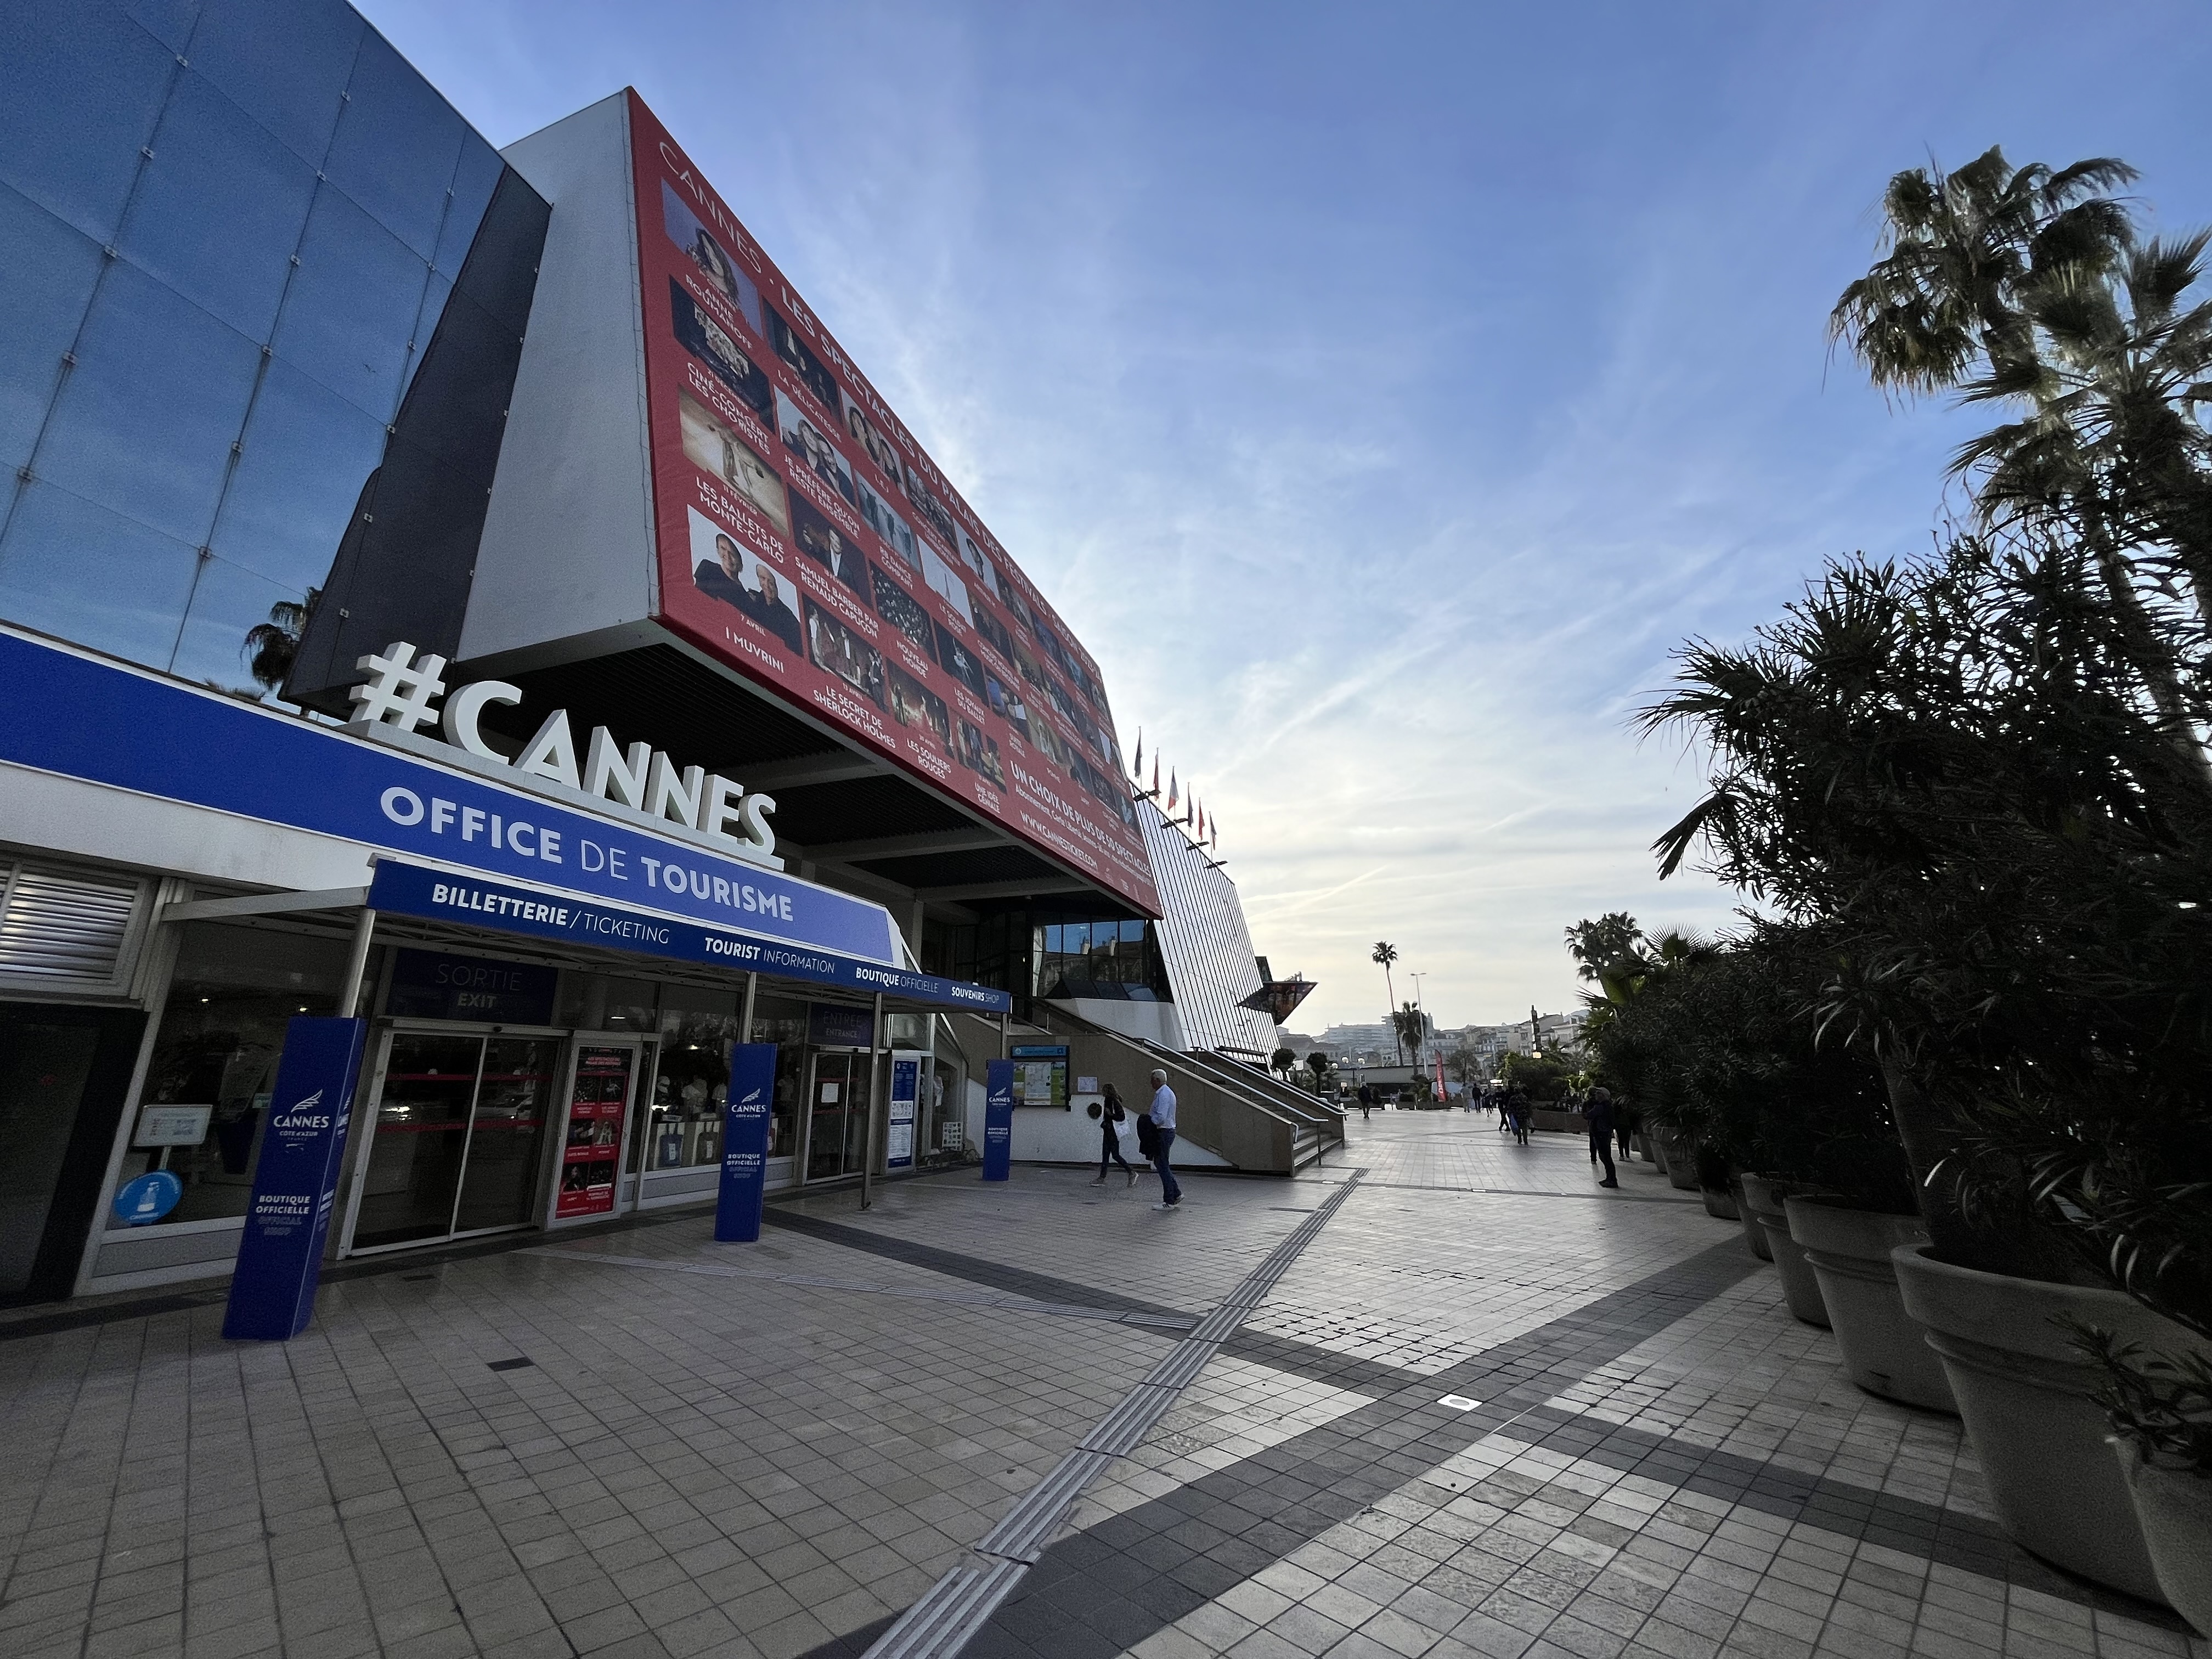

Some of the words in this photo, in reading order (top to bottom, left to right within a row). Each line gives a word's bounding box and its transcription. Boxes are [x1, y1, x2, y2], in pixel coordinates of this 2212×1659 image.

[686, 274, 752, 348] ROUMANOFF
[705, 288, 733, 322] ANNE
[659, 142, 761, 273] CANNES
[781, 286, 815, 337] LES
[821, 335, 915, 456] SPECTACLES
[918, 452, 938, 484] DU
[941, 480, 980, 535] PALAIS
[981, 530, 1002, 562] DES
[1003, 556, 1046, 615] FESTIVALS
[716, 376, 748, 411] DÉCEMBRE
[687, 362, 768, 442] CINÉ-CONCERT
[689, 373, 708, 397] LES
[712, 396, 770, 454] CHORISTES
[777, 369, 789, 386] LA
[791, 384, 841, 442] DÉLICATESSE
[729, 486, 757, 516] FÉVRIER
[784, 454, 794, 469] JE
[795, 465, 831, 504] PRÉFÈRE
[833, 502, 860, 531] QU'ON
[789, 467, 816, 498] RESTE
[817, 495, 858, 538] ENSEMBLE
[696, 476, 717, 500] LES
[721, 496, 767, 539] BALLETS
[770, 535, 784, 554] DE
[700, 492, 783, 563] MONTE-CARLO
[881, 556, 912, 589] COMPANY
[890, 556, 912, 582] DANCE
[795, 556, 830, 592] SAMUEL
[832, 586, 863, 618] BARBER
[864, 613, 878, 631] PAR
[801, 571, 837, 606] RENAUD
[839, 603, 877, 638] CAPUÇON
[746, 619, 765, 636] AVRIL
[725, 626, 729, 639] I
[733, 633, 783, 673] MUVRINI
[896, 640, 928, 670] NOUVEAU
[902, 654, 926, 678] MONDE
[826, 685, 837, 700] LE
[838, 693, 868, 720] SECRET
[871, 714, 883, 729] DE
[842, 682, 848, 691] 13
[849, 687, 864, 701] AVRIL
[954, 687, 964, 700] LES
[957, 697, 966, 710] DU
[813, 690, 861, 727] SHERLOCK
[862, 720, 895, 748] HOLMES
[348, 641, 776, 857] #CANNES
[906, 738, 919, 753] LES
[920, 747, 951, 773] SOULIERS
[917, 755, 945, 779] ROUGES
[974, 781, 987, 796] UNE
[986, 790, 999, 804] IDÉE
[977, 793, 1000, 813] GÉNIALE
[1010, 760, 1028, 786] UN
[1029, 776, 1062, 811] CHOIX
[1061, 800, 1075, 821] DE
[1074, 810, 1095, 836] PLUS
[1094, 825, 1106, 844] DE
[1114, 841, 1151, 877] SPECTACLES
[380, 786, 562, 864] OFFICE
[580, 839, 628, 880] DE
[641, 856, 793, 922] TOURISME
[432, 883, 568, 926] BILLETTERIE
[584, 913, 670, 945] TICKETING
[705, 937, 760, 960] TOURIST
[763, 949, 835, 974] INFORMATION
[435, 963, 522, 991] SORTIE
[856, 967, 899, 987] BOUTIQUE
[900, 975, 939, 994] OFFICIELLE
[457, 992, 497, 1008] EXIT
[951, 986, 985, 1002] SOUVENIRS
[823, 1011, 864, 1027] ENTRÉE
[826, 1028, 857, 1039] ENTRANCE
[273, 1115, 330, 1128] CANNES
[731, 1104, 766, 1113] CANNES
[256, 1206, 310, 1214] OFFICIELLE
[259, 1195, 311, 1205] BOUTIQUE
